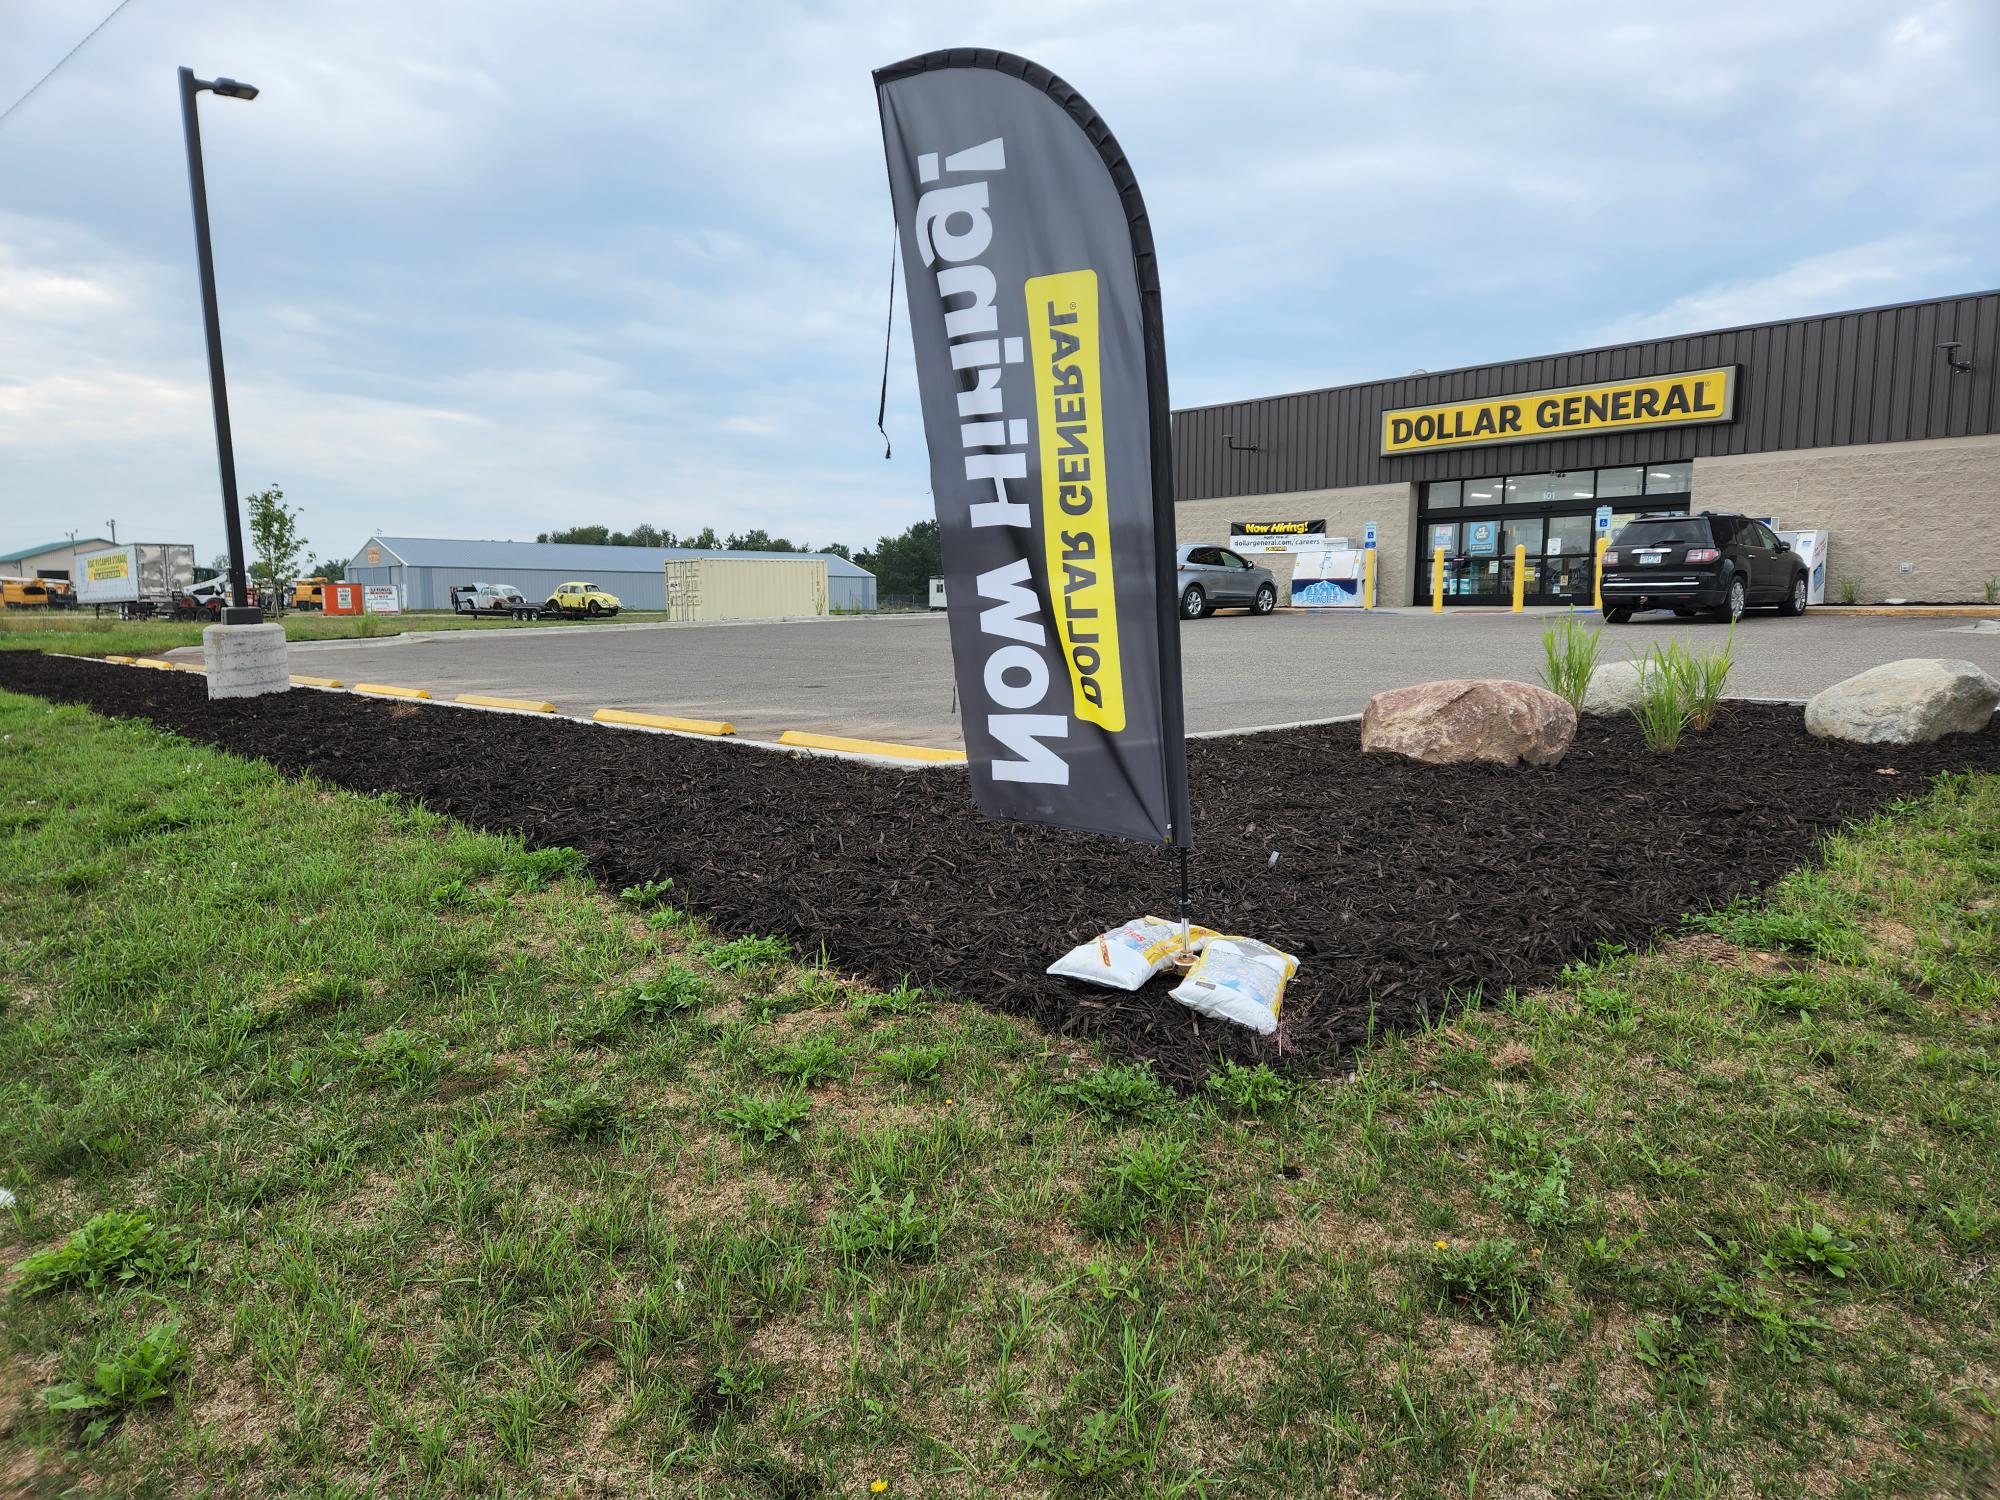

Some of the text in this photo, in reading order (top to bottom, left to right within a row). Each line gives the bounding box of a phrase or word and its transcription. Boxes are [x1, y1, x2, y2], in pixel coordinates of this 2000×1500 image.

[1391, 381, 1716, 445] DOLLAR GENERAL
[1543, 491, 1556, 500] 101
[1245, 521, 1309, 534] Now Hiring!
[1235, 539, 1320, 547] dollargeneral.com/careers
